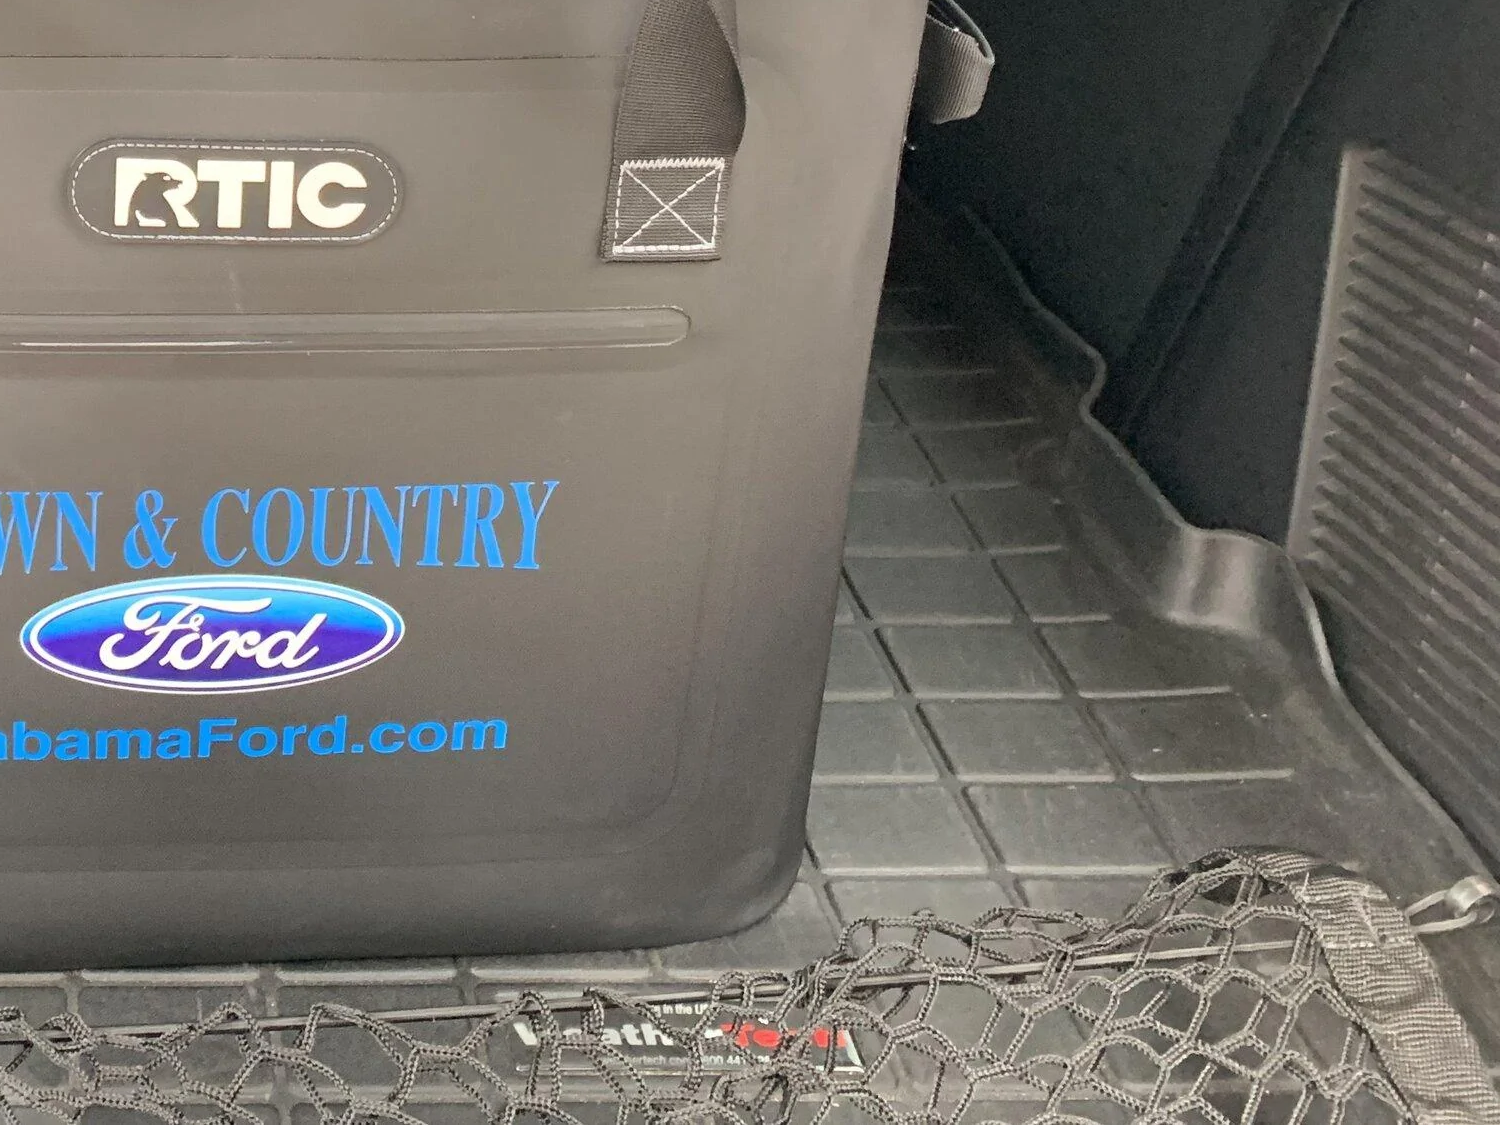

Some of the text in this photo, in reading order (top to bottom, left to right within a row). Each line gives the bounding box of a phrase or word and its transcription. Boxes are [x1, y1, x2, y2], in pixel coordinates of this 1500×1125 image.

[114, 157, 368, 228] RTIC
[123, 489, 177, 569] &
[201, 480, 560, 570] COUNTRY
[99, 595, 328, 671] Ford
